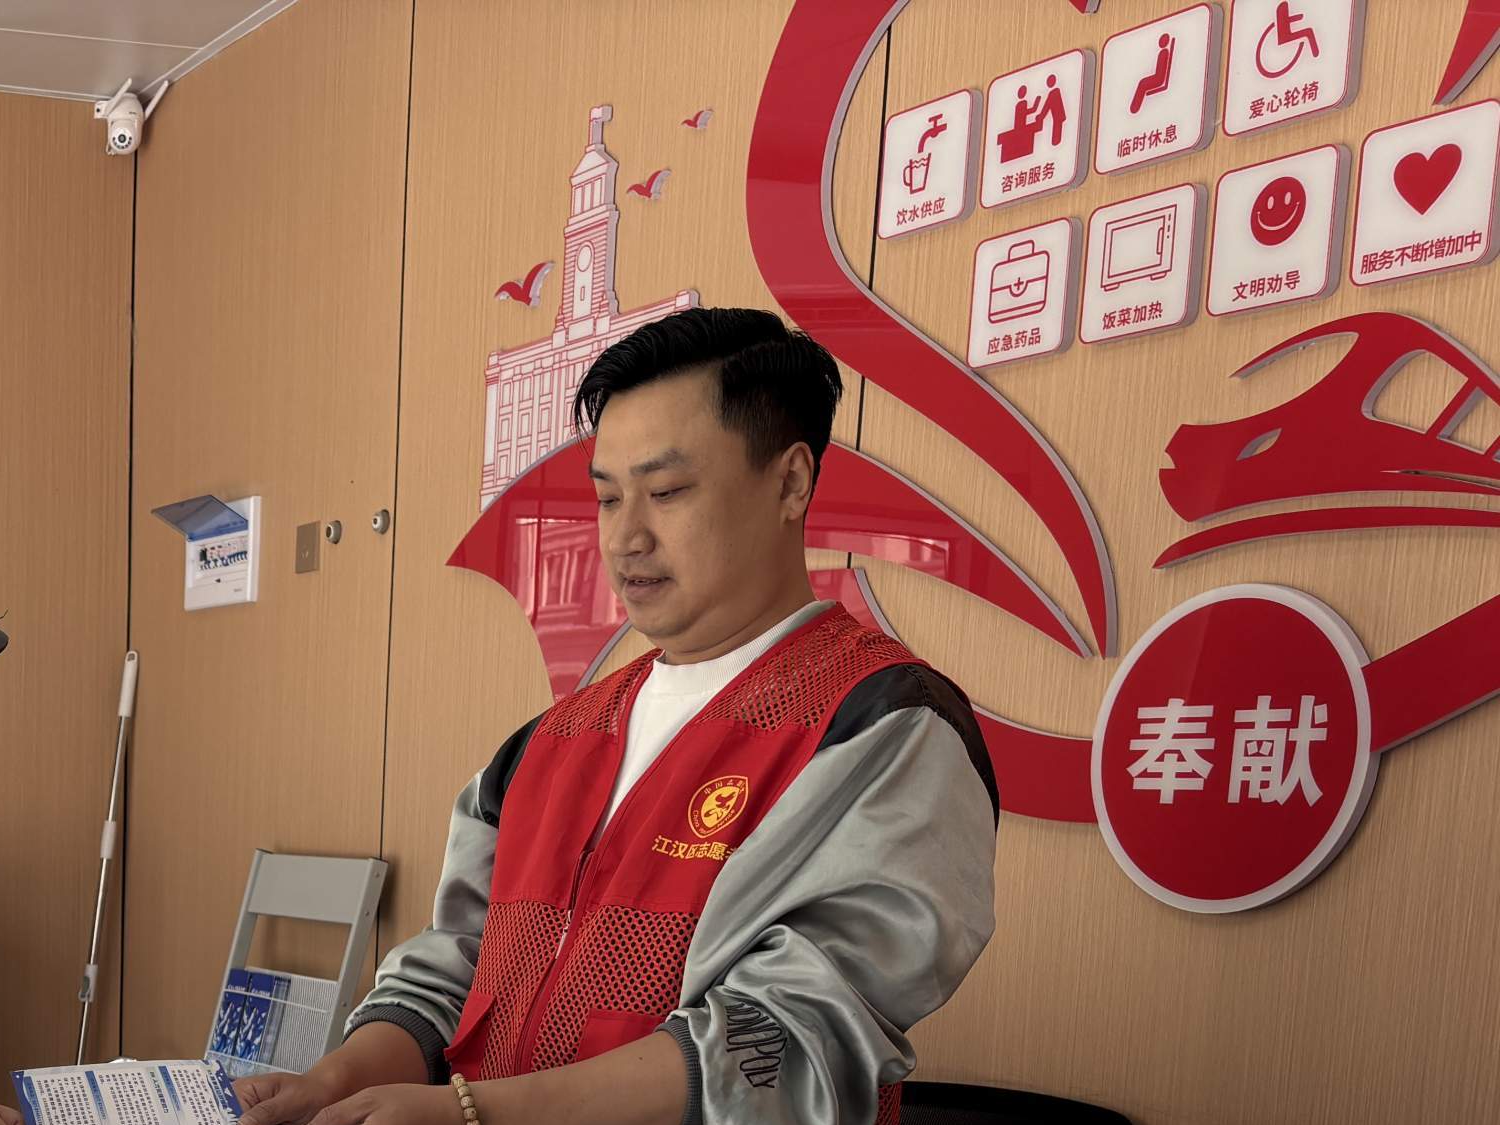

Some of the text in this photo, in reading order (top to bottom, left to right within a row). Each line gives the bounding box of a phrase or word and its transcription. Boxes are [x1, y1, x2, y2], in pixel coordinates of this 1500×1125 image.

[1249, 81, 1320, 120] 爱心轮椅
[1117, 124, 1179, 158] 临时休息
[1000, 163, 1056, 194] 咨询服务
[895, 197, 946, 226] 饮水供应
[1359, 230, 1483, 275] 服务不断增加中
[1232, 270, 1301, 302] 文明劝导
[1102, 301, 1164, 331] 饭菜加热
[986, 328, 1042, 355] 应急药品
[1126, 695, 1328, 807] 奉献
